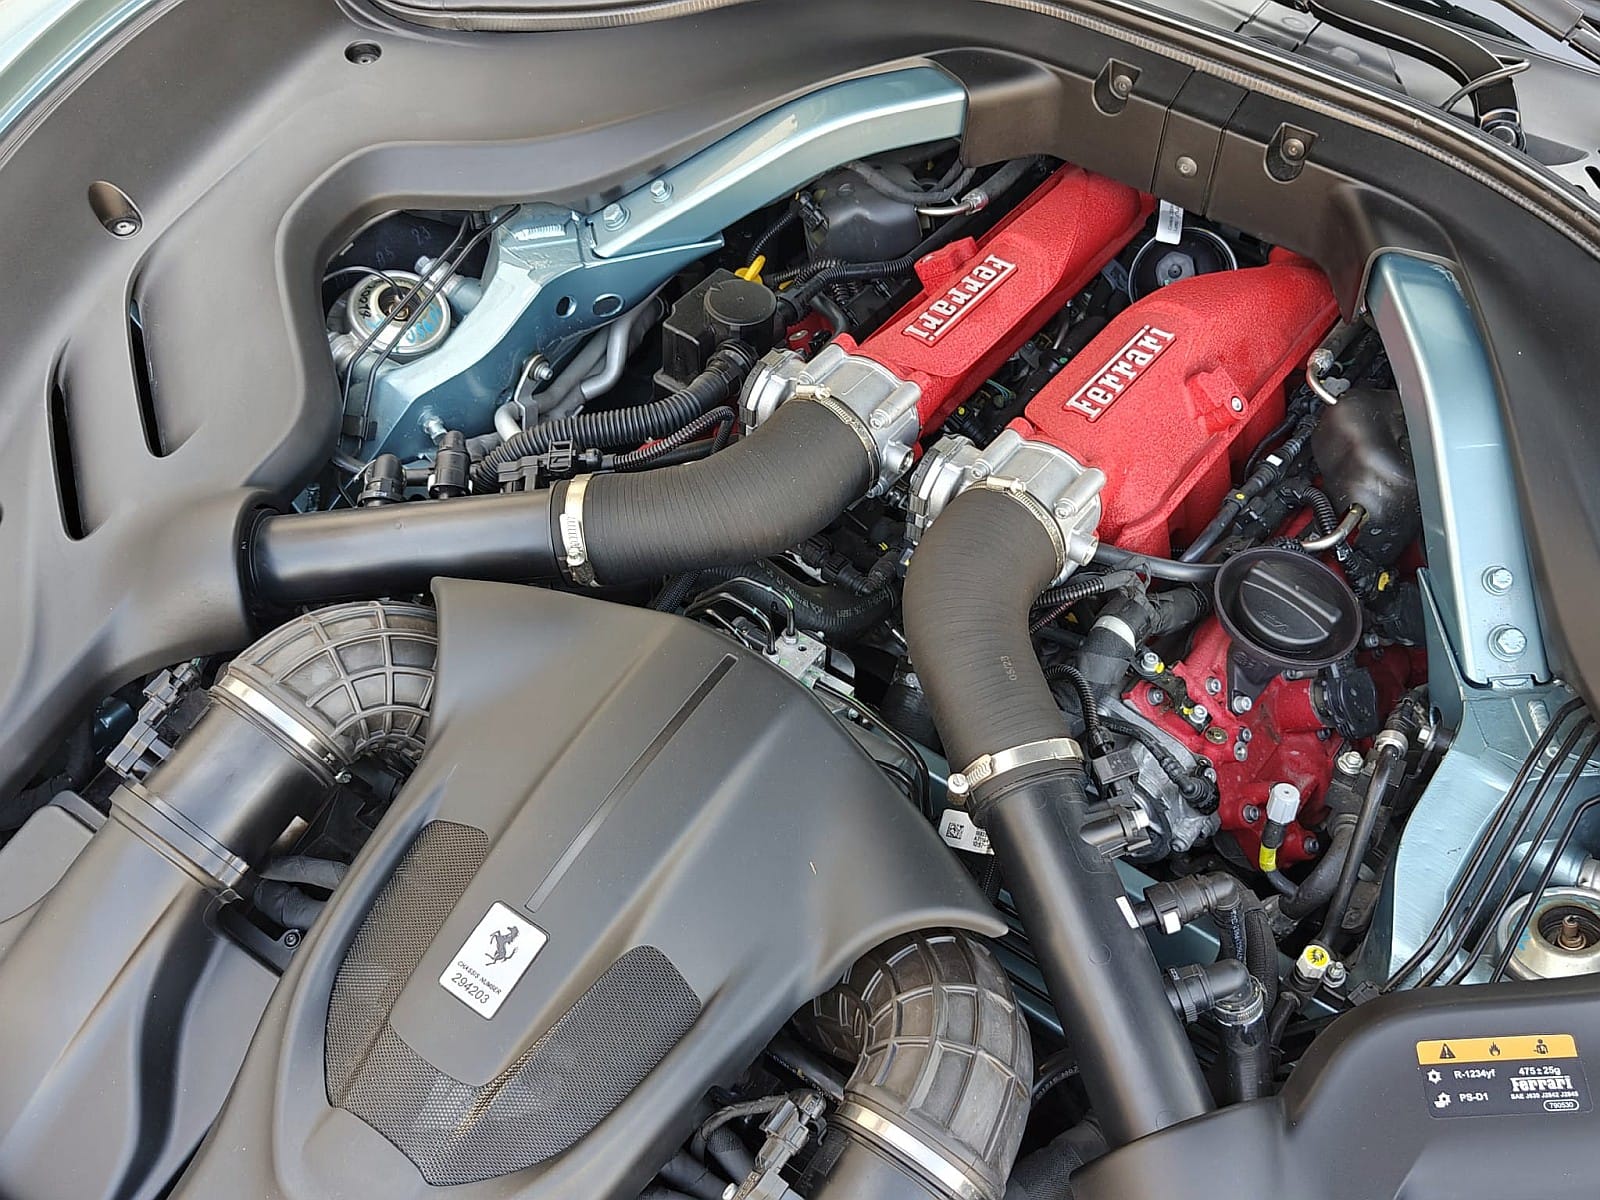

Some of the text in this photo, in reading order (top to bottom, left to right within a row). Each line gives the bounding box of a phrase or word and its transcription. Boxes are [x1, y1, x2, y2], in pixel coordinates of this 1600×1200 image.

[904, 254, 1017, 342] Ferrari
[1066, 324, 1176, 420] Ferrari
[451, 972, 490, 1004] 294203
[457, 961, 502, 995] CHASSIS NUMBER
[1453, 1068, 1497, 1080] R-1234yf
[1509, 1075, 1574, 1092] Ferrari
[1459, 1092, 1489, 1102] PS-D1
